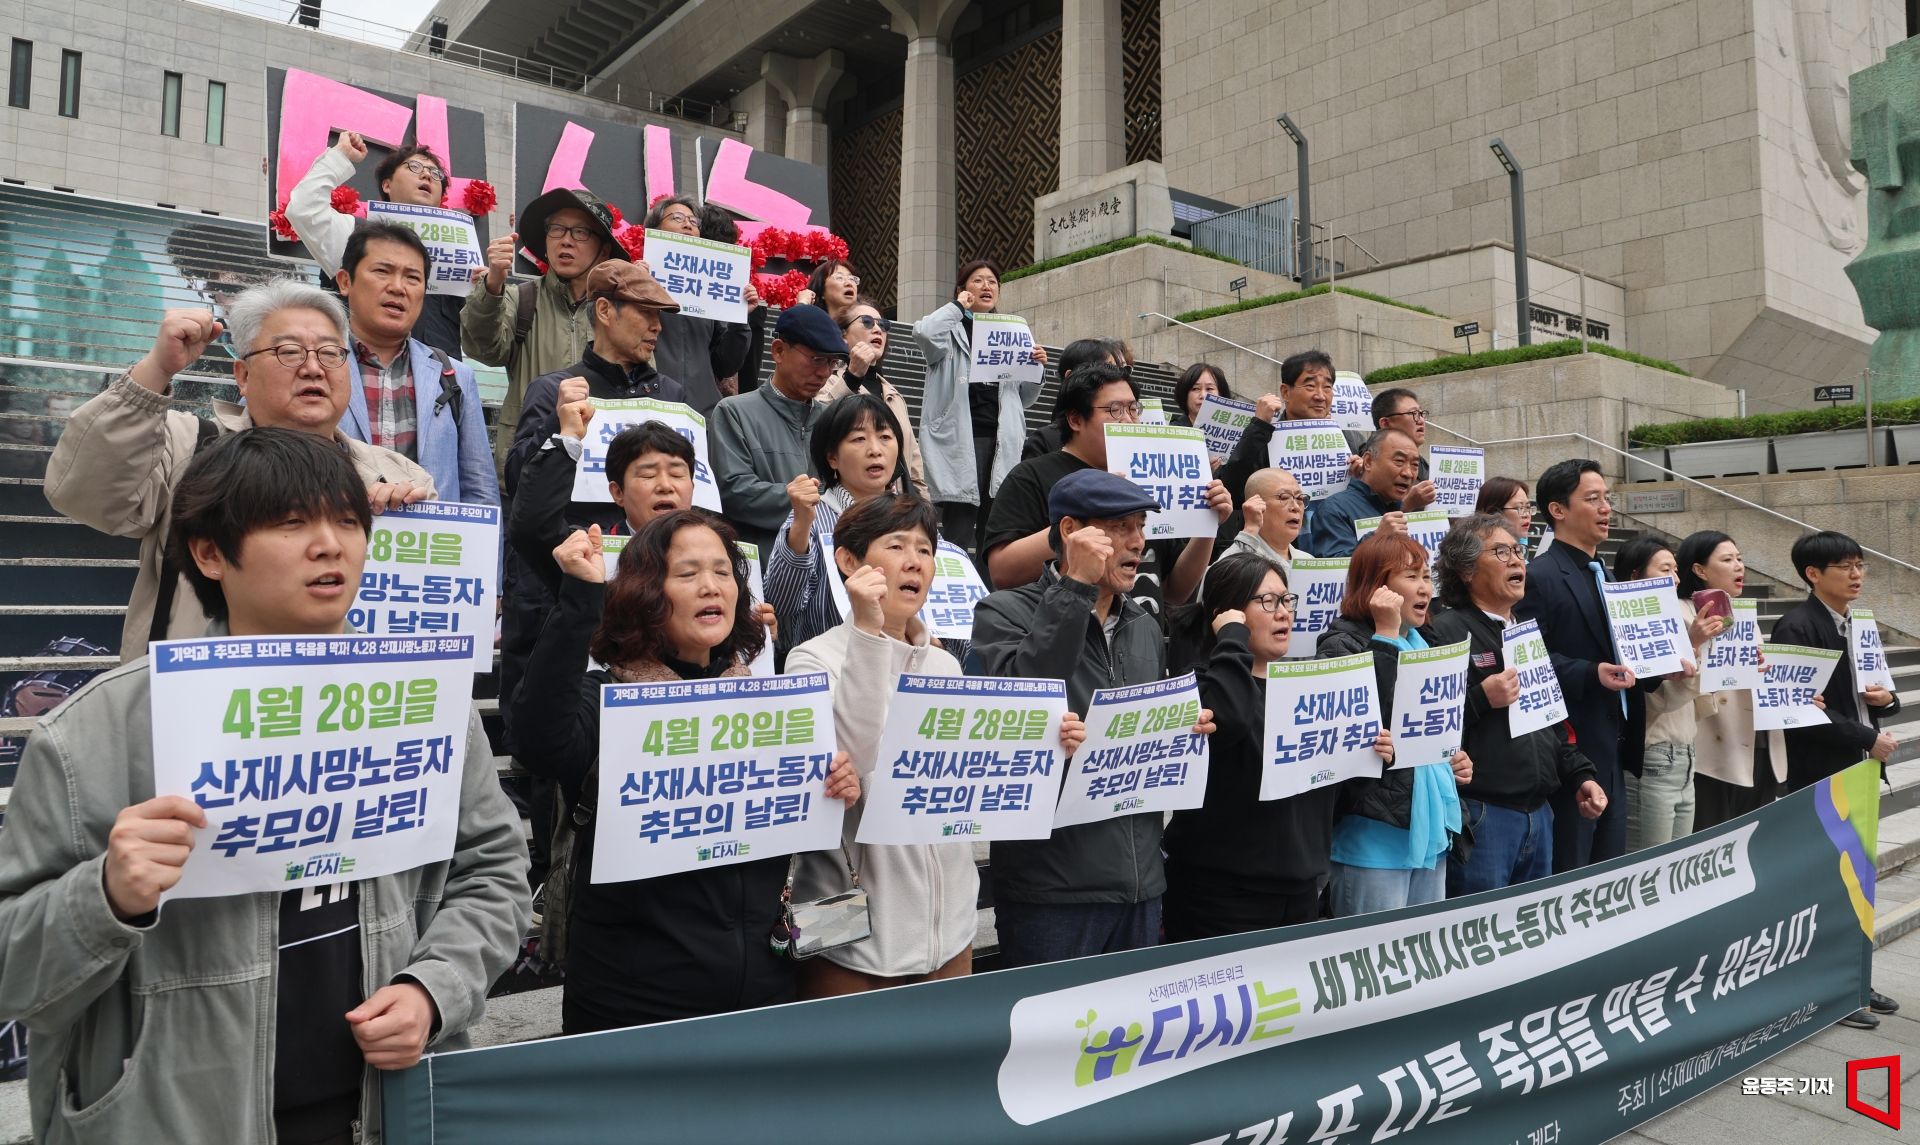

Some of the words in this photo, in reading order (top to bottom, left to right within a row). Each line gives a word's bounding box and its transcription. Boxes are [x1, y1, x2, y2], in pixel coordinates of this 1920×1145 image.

[420, 223, 469, 245] 28일을
[427, 247, 480, 265] 망노동자
[664, 251, 733, 280] 산재사망
[436, 266, 473, 282] 날로!
[707, 282, 740, 304] 추모
[988, 331, 1032, 348] 산재사망
[977, 350, 1014, 366] 노동자
[1211, 409, 1232, 425] 4월
[1285, 435, 1308, 451] 4월
[1311, 433, 1346, 450] 28일을
[1130, 453, 1200, 479] 산재사망
[1439, 460, 1452, 473] 4월
[1454, 460, 1478, 475] 28일을
[1436, 492, 1457, 505] 추모의
[1459, 493, 1476, 505] 날로!
[359, 572, 485, 606] 망노동자
[932, 609, 973, 627] 날로
[1617, 596, 1662, 619] 28일을
[169, 645, 210, 663] 기억과
[214, 643, 254, 660] 추모로
[256, 642, 292, 657] 또다른
[295, 641, 327, 656] 죽음을
[329, 641, 350, 656] 막자!
[352, 641, 377, 655] 4.28
[379, 639, 437, 655] 산재사망노동자
[438, 638, 460, 653] 추모의
[1639, 639, 1677, 660] 날로!
[1707, 646, 1737, 668] 노동자
[927, 678, 946, 689] 추모로
[998, 681, 1013, 691] 4.28
[1763, 665, 1818, 683] 산재사망
[613, 688, 639, 701] 기억과
[641, 686, 666, 699] 추모로
[668, 685, 692, 698] 또다른
[694, 683, 716, 696] 죽음을
[718, 682, 737, 694] 막자!
[739, 681, 761, 692] 4.28
[1519, 687, 1552, 713] 추모의
[1757, 687, 1789, 708] 노동자
[1791, 687, 1817, 706] 추모
[222, 685, 303, 740] 4월
[316, 678, 438, 733] 28일을
[1293, 686, 1370, 725] 산재사망
[642, 717, 700, 757] 4월
[711, 707, 816, 752] 28일을
[918, 707, 965, 740] 4월
[968, 708, 1049, 741] 28일을
[1105, 710, 1141, 739] 4월
[1141, 699, 1199, 734] 28일을
[1401, 705, 1461, 739] 노동자
[1082, 733, 1205, 774] 산재사망노동자
[1275, 727, 1339, 765] 노동자
[1342, 720, 1379, 752] 추모
[191, 735, 453, 809] 산재사망노동자
[892, 750, 1055, 779] 산재사망노동자
[620, 752, 833, 806] 산재사망노동자
[1086, 769, 1142, 800] 추모의
[1143, 762, 1188, 790] 날로!
[901, 785, 975, 815] 추모의
[979, 783, 1033, 812] 날로!
[210, 802, 343, 858] 추모의
[351, 787, 428, 840] 날로!
[640, 802, 735, 844] 추모의
[745, 792, 811, 831] 날로!
[952, 822, 982, 836] 다시는
[711, 842, 751, 860] 다시는
[303, 857, 356, 878] 다시는
[1138, 984, 1301, 1067] 다시는
[1309, 896, 1568, 1014] 세계산재사망노동자
[1570, 874, 1637, 929] 추모의
[1639, 866, 1660, 907] 날
[1668, 840, 1737, 895] 기자회견
[1149, 965, 1244, 1002] 산재피해가족네트워크
[1371, 1041, 1482, 1144] 다른
[1478, 993, 1608, 1095] 죽음을
[1603, 966, 1678, 1043] 막을
[1674, 954, 1708, 1015] 수
[1712, 903, 1819, 1000] 있습니다
[1618, 1076, 1647, 1117] 주최
[1658, 1016, 1787, 1097] 산재피해가족네트워크
